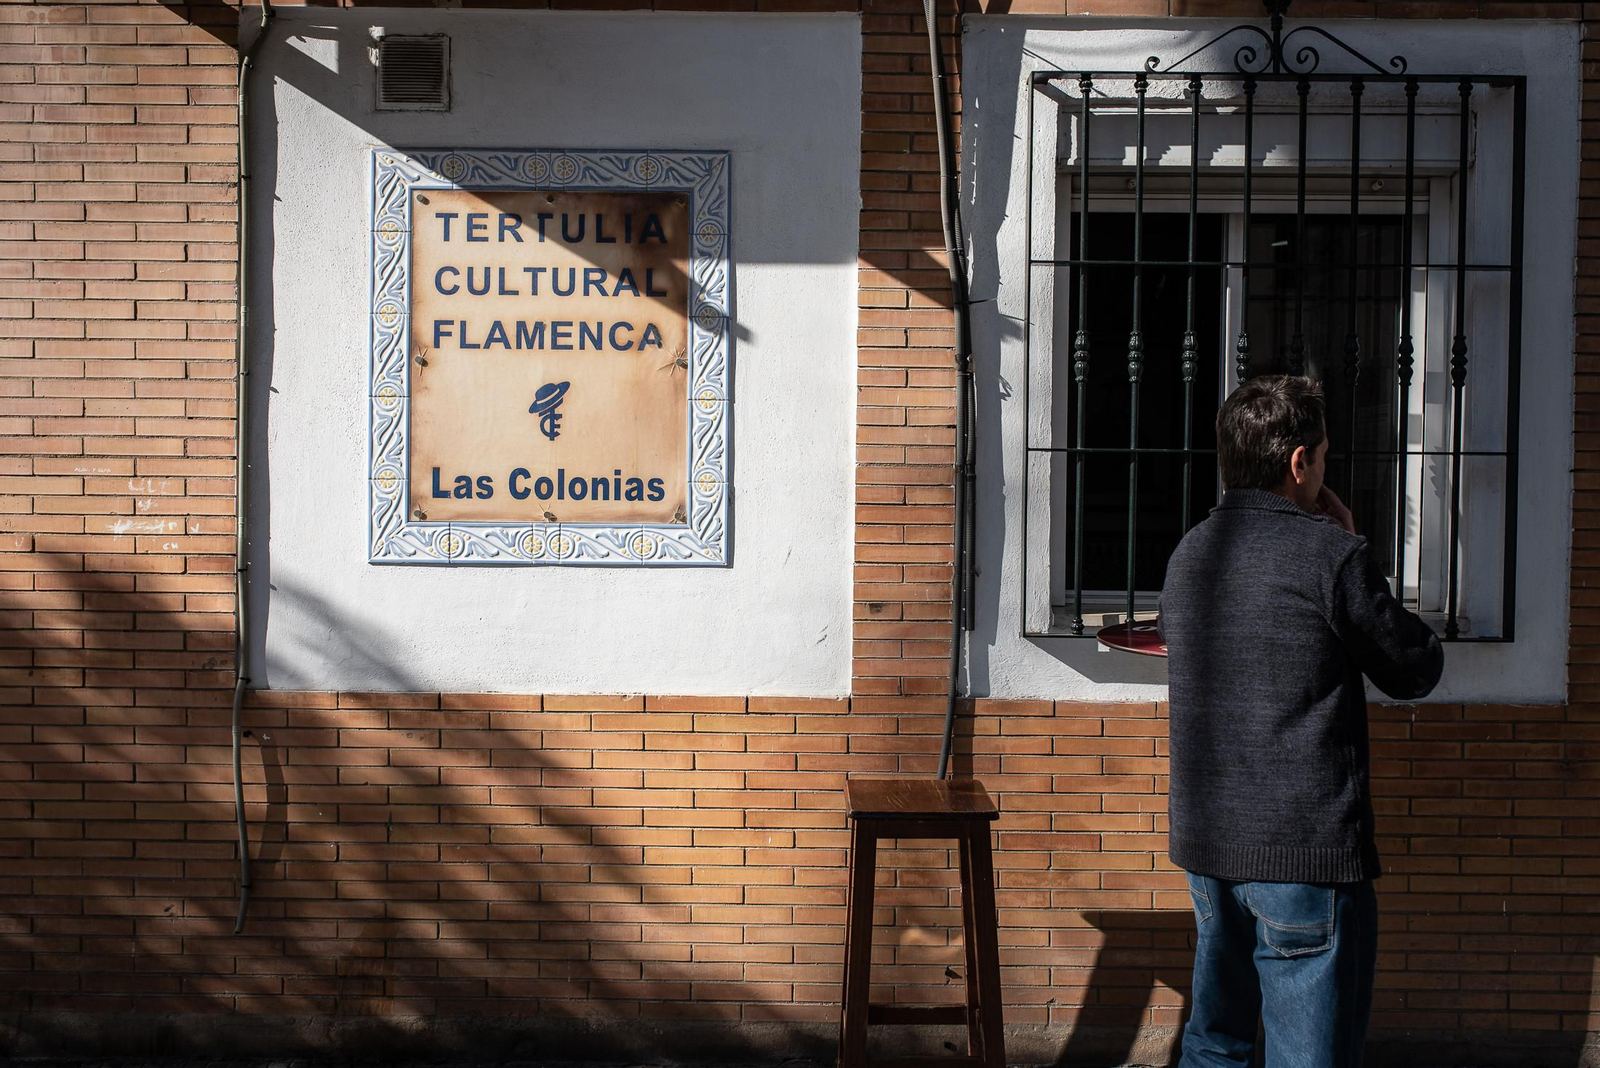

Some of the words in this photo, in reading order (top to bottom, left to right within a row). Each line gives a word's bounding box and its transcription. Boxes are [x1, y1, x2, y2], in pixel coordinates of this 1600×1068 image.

[434, 212, 668, 244] TERTULIA
[434, 266, 667, 297] CULTURAL
[432, 320, 664, 351] FLAMENCA
[431, 467, 495, 500] Las
[508, 467, 666, 502] Colonias
